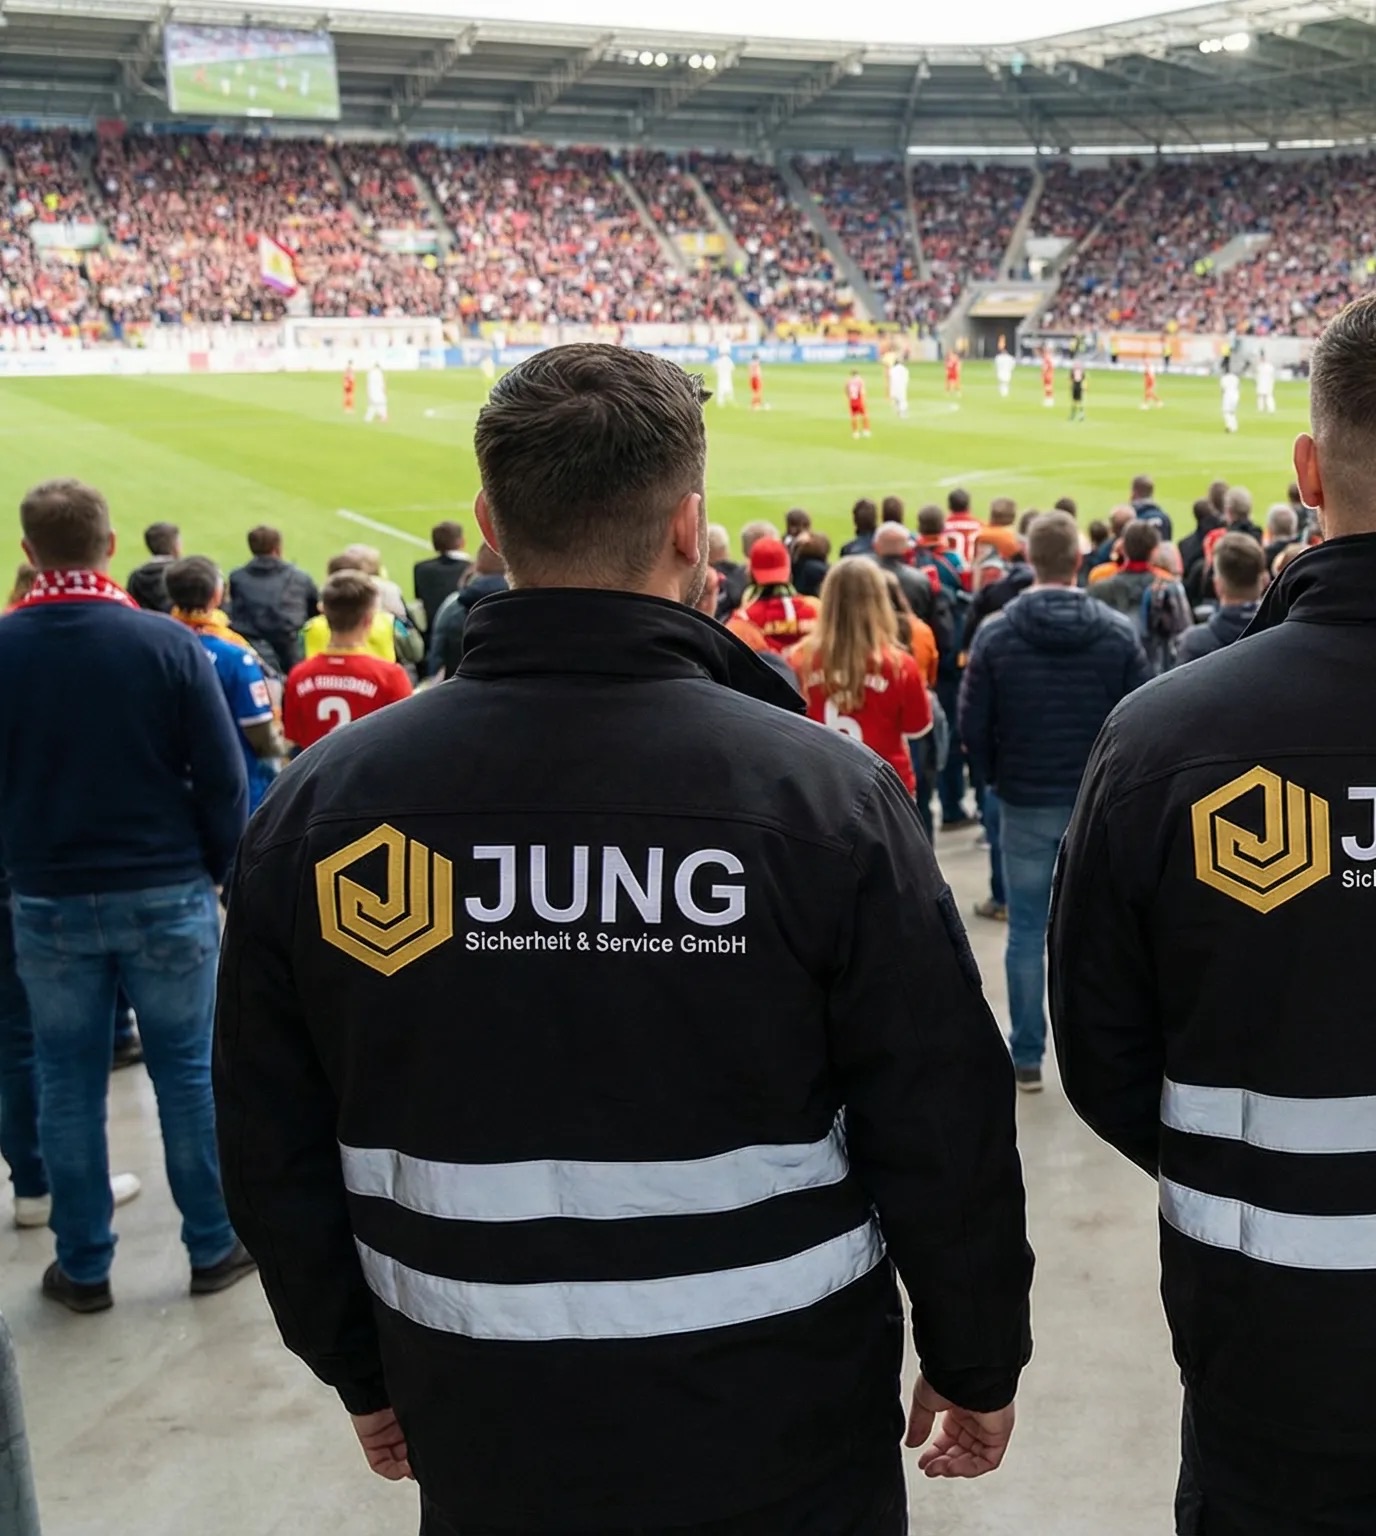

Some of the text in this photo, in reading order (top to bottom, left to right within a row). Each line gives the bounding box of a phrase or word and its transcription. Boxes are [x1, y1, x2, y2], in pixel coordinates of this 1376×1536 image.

[465, 845, 746, 926] JUNG
[465, 931, 746, 954] Sicherheit & Service GmbH
